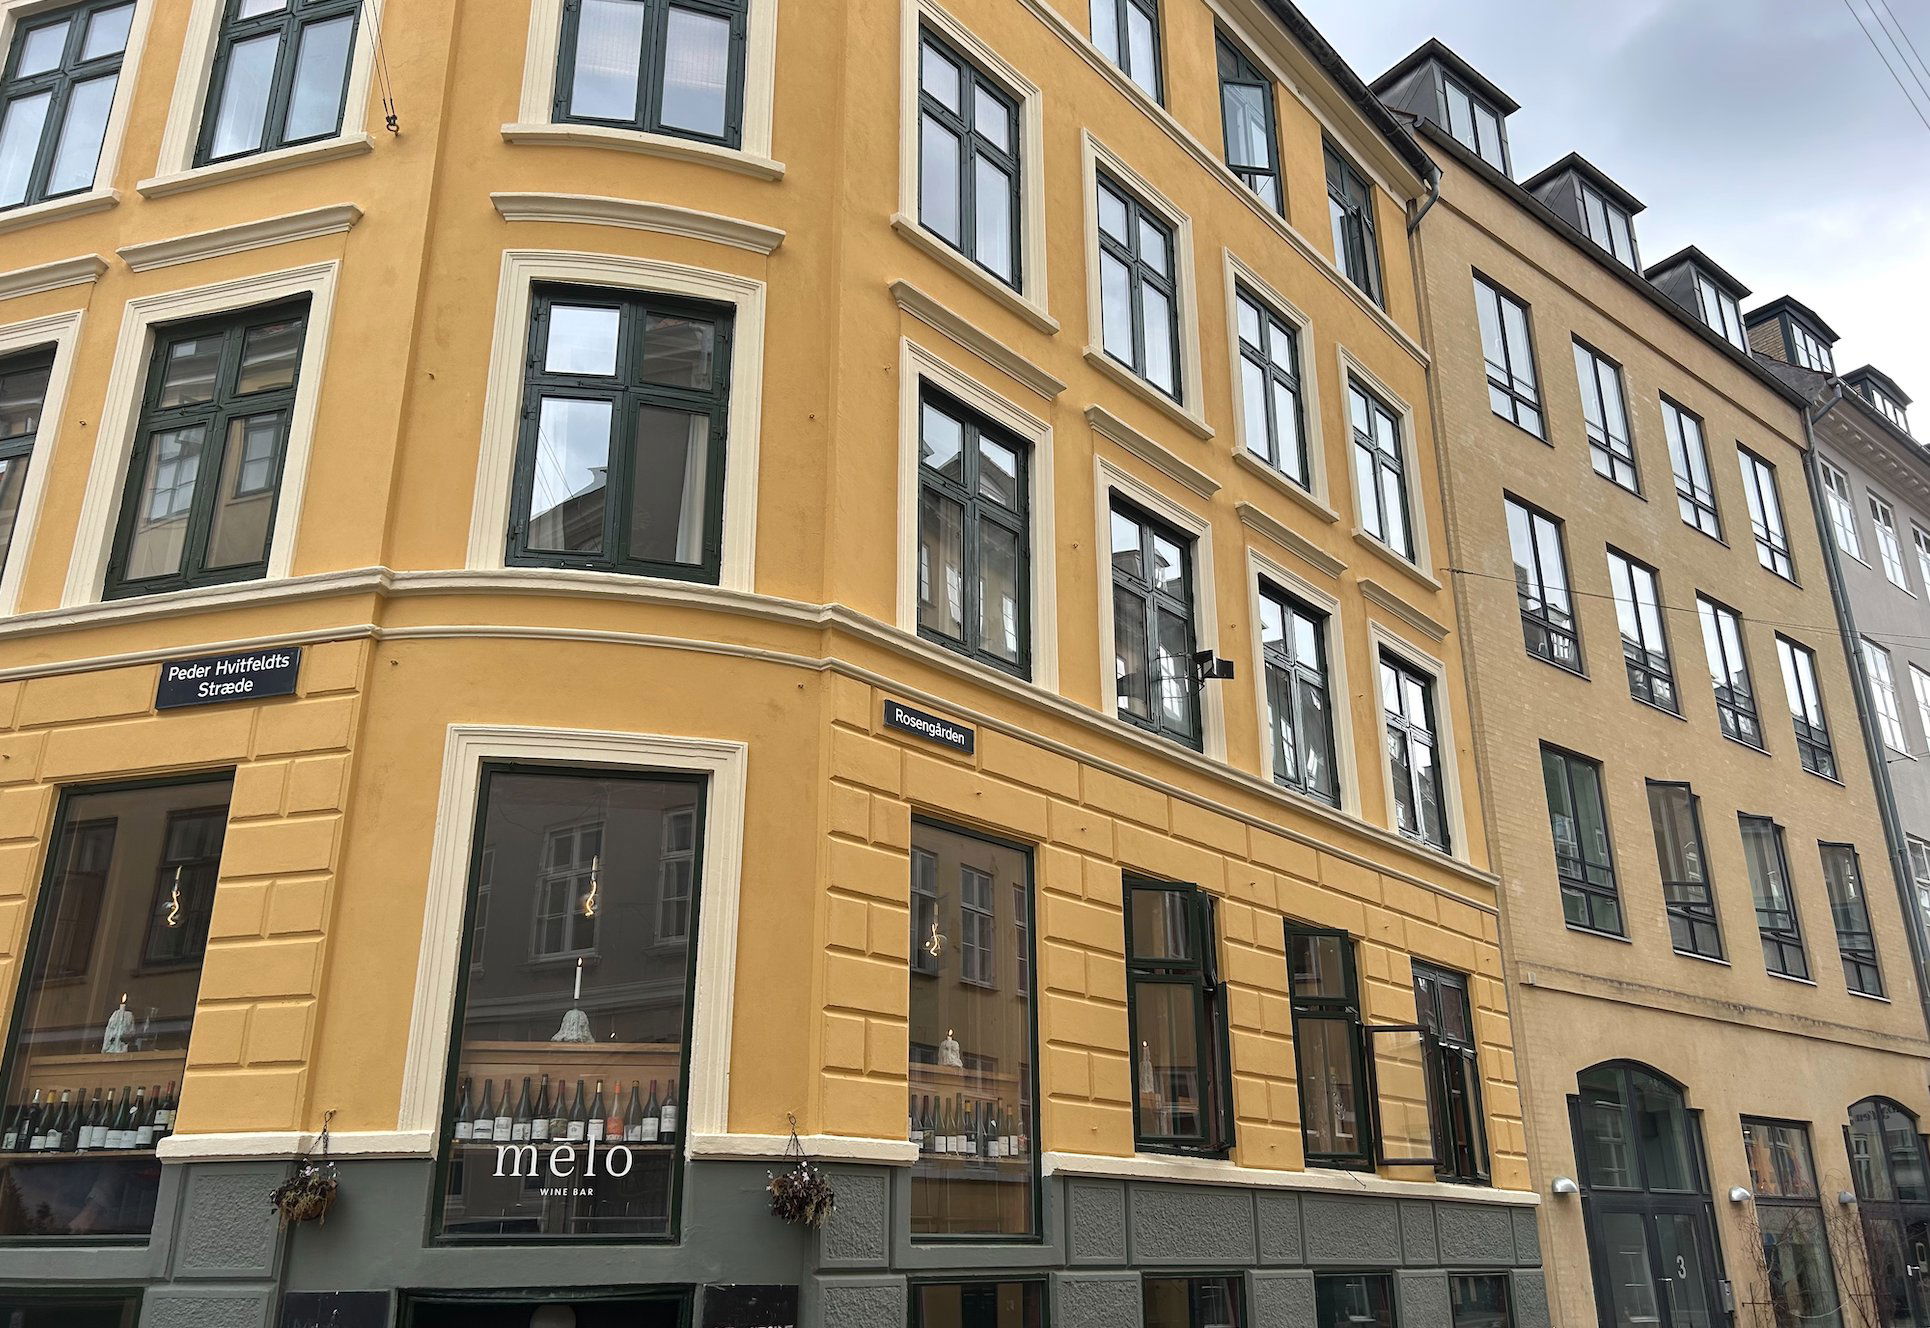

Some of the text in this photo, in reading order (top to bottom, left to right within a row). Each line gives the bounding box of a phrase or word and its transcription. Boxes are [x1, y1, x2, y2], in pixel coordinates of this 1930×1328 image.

[168, 654, 290, 681] Peder Hvitfeldts
[198, 678, 254, 697] Stræde
[895, 708, 965, 745] Rosengården
[539, 1187, 594, 1196] WINE BAR
[1676, 1255, 1687, 1279] 3
